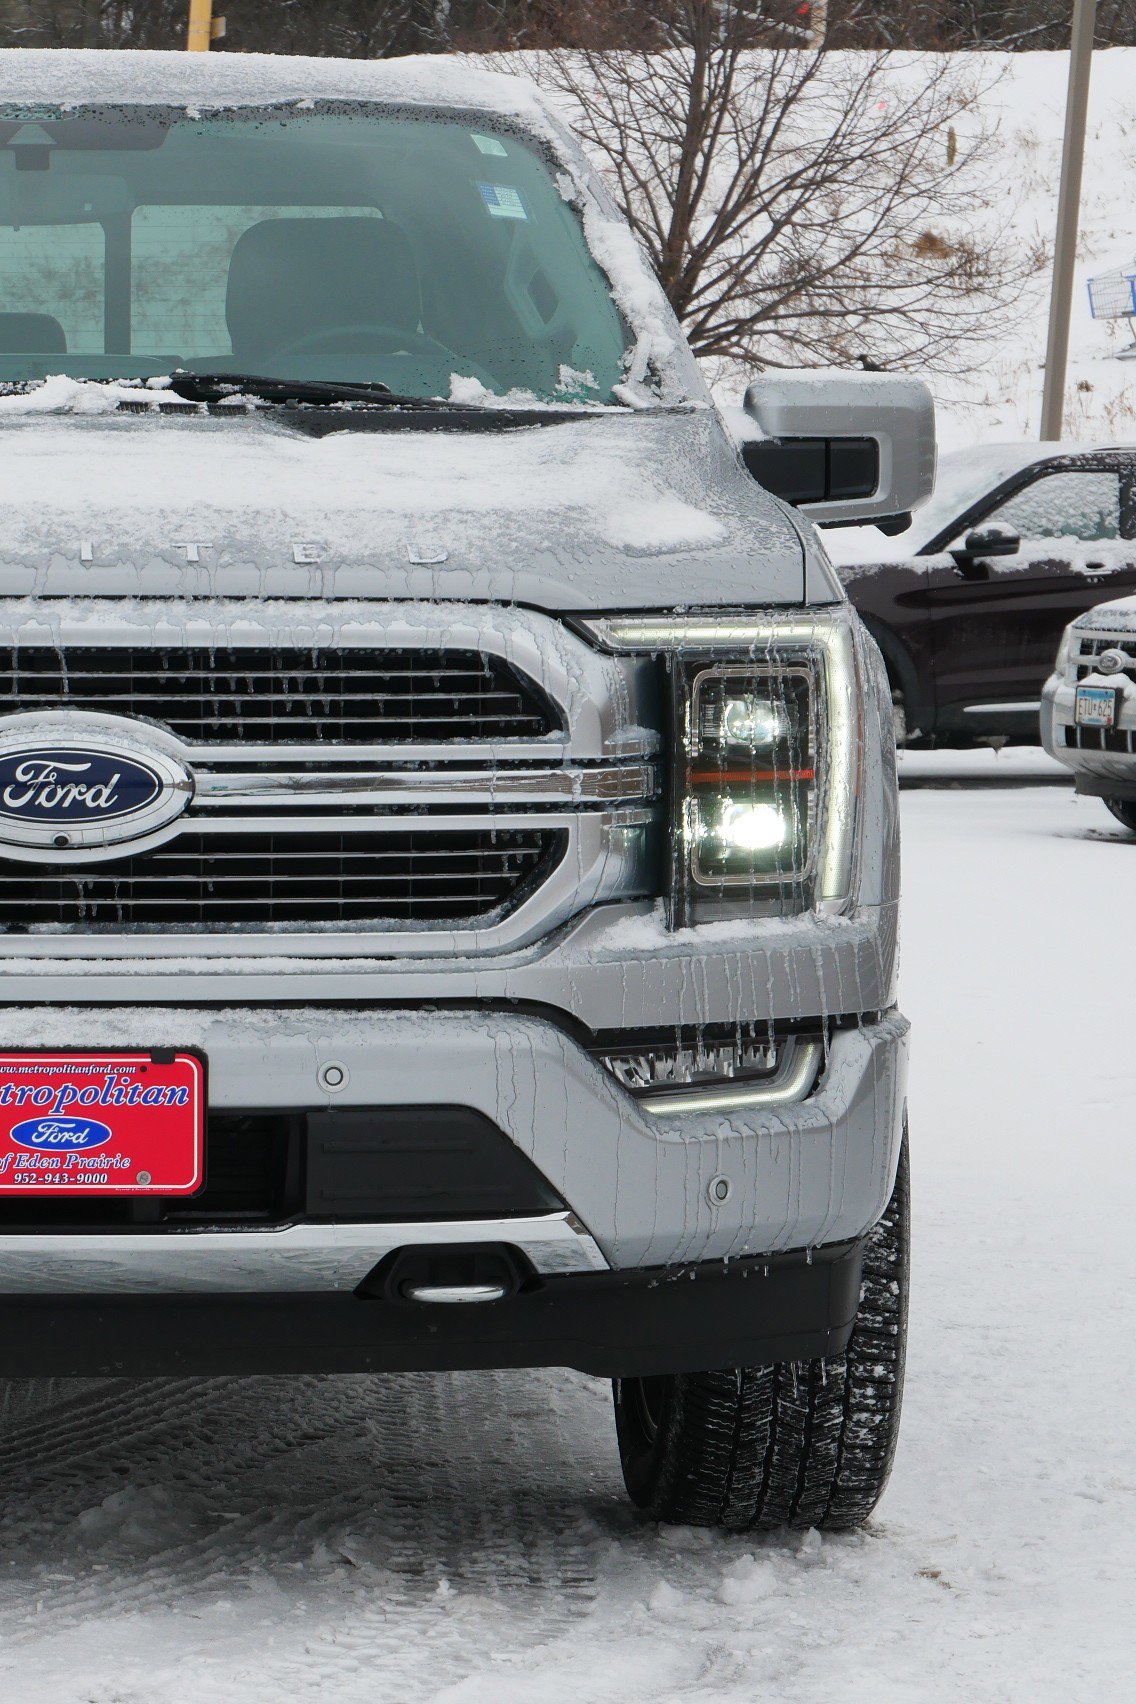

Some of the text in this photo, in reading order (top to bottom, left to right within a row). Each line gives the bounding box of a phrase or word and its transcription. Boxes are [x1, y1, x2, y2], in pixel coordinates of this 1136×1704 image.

[2, 760, 121, 808] Ford
[31, 1121, 89, 1144] Ford
[14, 1153, 60, 1169] Eden
[63, 1153, 131, 1169] Prairie
[14, 1172, 108, 1184] 952-943-9000
